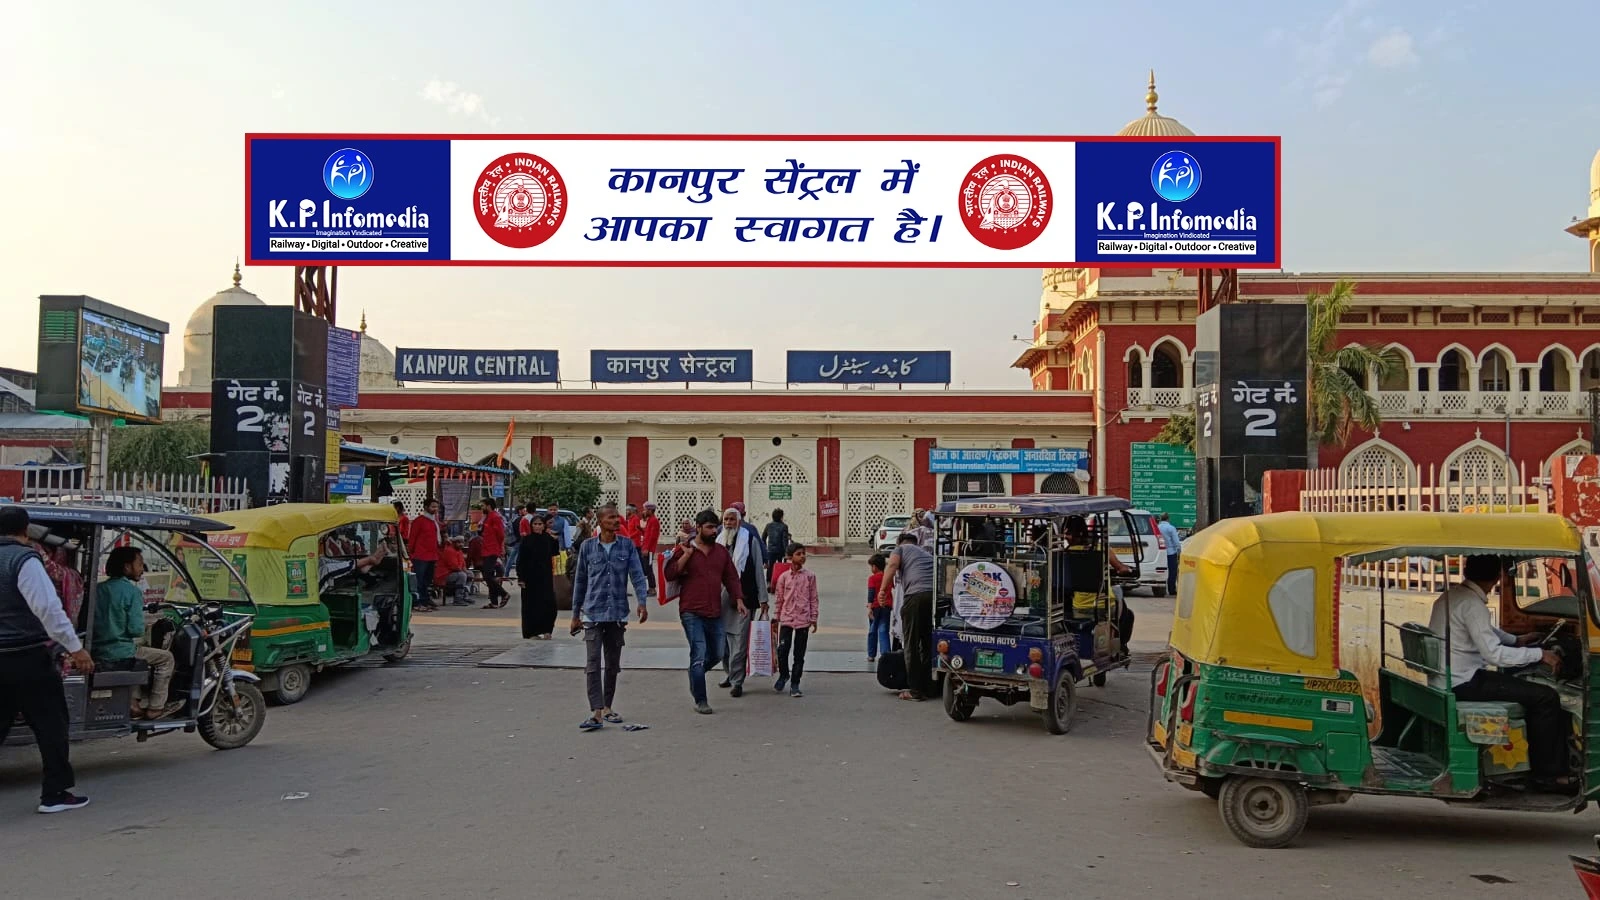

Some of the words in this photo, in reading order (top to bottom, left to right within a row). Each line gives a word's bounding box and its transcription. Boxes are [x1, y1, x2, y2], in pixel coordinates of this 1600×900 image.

[478, 179, 492, 216] भारतीय
[486, 164, 504, 178] रेल
[514, 158, 550, 177] INDIAN
[546, 174, 562, 227] RAILWAYS
[607, 167, 745, 204] कानपुर
[763, 158, 861, 201] सेंट्रल
[880, 158, 921, 195] में
[963, 180, 977, 218] भारतीय
[971, 166, 989, 180] रेल
[999, 159, 1035, 178] INDIAN
[1031, 175, 1047, 228] RAILWAYS
[315, 229, 350, 238] Imagination
[351, 229, 382, 237] Vindicated
[583, 215, 713, 243] आपका
[734, 216, 875, 243] स्वागत
[1144, 232, 1178, 240] Imagination
[270, 239, 305, 251] Railway
[311, 239, 340, 251] Digital
[346, 239, 383, 249] Outdoor
[390, 239, 428, 249] Creative
[1098, 241, 1133, 253] Railway
[1139, 241, 1168, 253] Digital
[1173, 241, 1211, 251] Outdoor
[1217, 241, 1255, 251] Creative
[402, 354, 468, 375] KANPUR
[474, 355, 551, 376] CENTRAL
[607, 357, 671, 380] कानपुर
[679, 351, 737, 378] सेन्ट्रल
[226, 380, 261, 402] गेट
[263, 380, 285, 402] नं.
[297, 383, 313, 406] गेट
[1231, 380, 1271, 404] गेट
[1273, 381, 1299, 404] नं.
[237, 405, 264, 432] 2
[303, 411, 316, 436] 2
[1204, 411, 1212, 437] 2
[1243, 408, 1277, 436] 2
